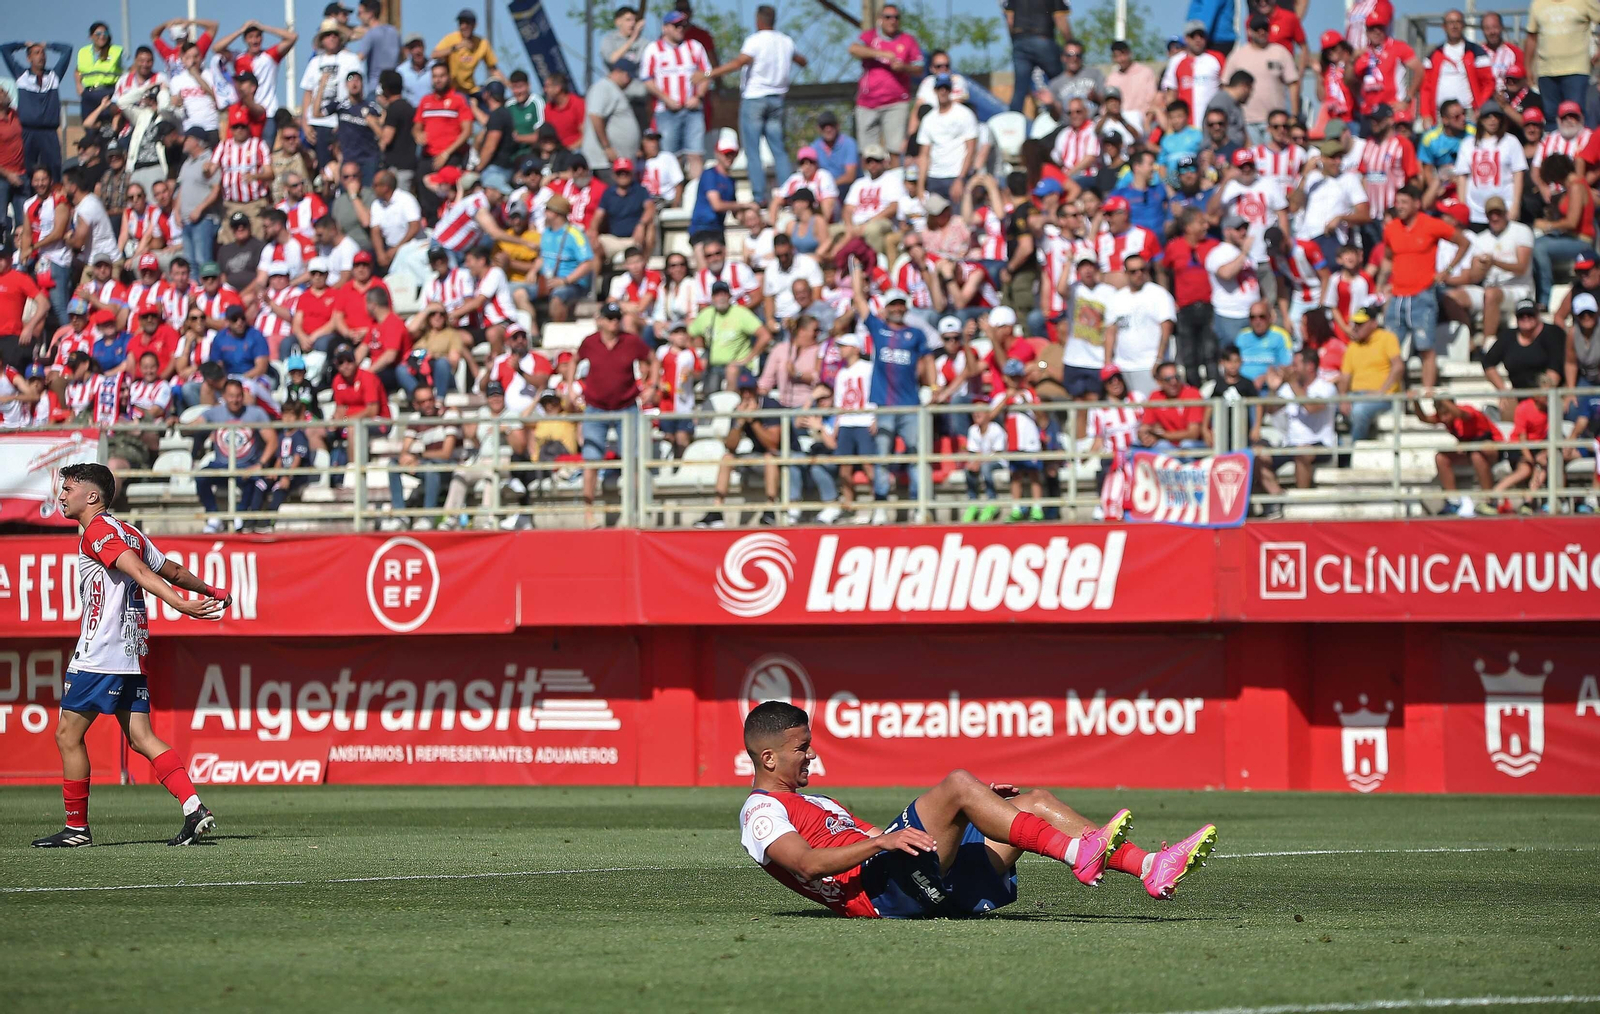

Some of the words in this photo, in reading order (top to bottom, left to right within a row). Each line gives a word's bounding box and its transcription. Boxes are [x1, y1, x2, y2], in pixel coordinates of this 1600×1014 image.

[19, 541, 258, 621] FEDCIÓN
[805, 530, 1127, 612] Lavahostel
[190, 663, 542, 742] Algetransit
[824, 690, 1054, 739] Grazalema
[1066, 688, 1204, 737] Motor
[210, 760, 321, 783] GIVOVA
[415, 745, 533, 763] REPRESENTANTES
[535, 747, 618, 764] ADUANEROS
